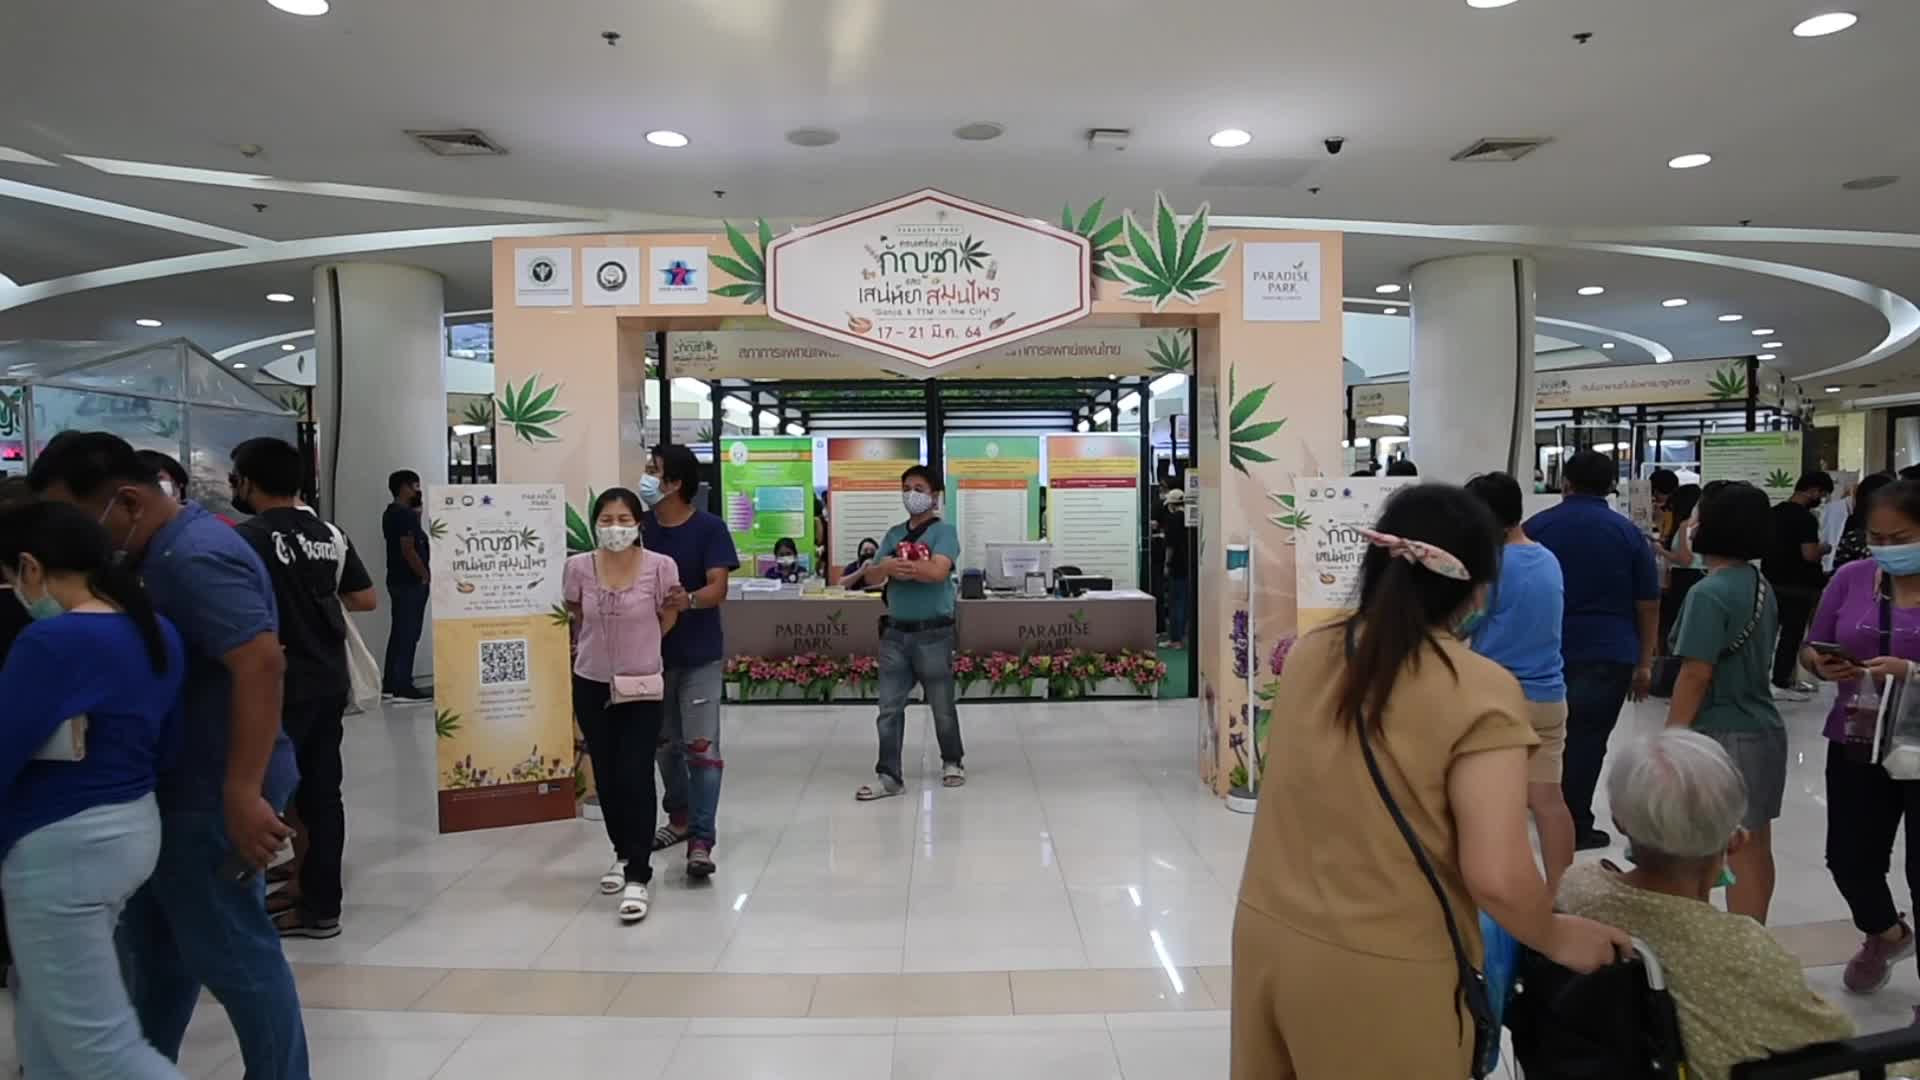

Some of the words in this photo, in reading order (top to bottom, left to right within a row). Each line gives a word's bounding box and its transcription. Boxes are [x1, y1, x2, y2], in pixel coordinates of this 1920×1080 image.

[879, 243, 958, 279] กัญชา
[1253, 271, 1309, 281] PARADISE
[1267, 282, 1297, 293] PARK
[878, 326, 893, 340] 17
[908, 326, 924, 339] 21
[965, 326, 982, 339] 64
[775, 623, 849, 638] PARADISE
[1018, 622, 1089, 640] PARADISE
[793, 638, 833, 650] PARK
